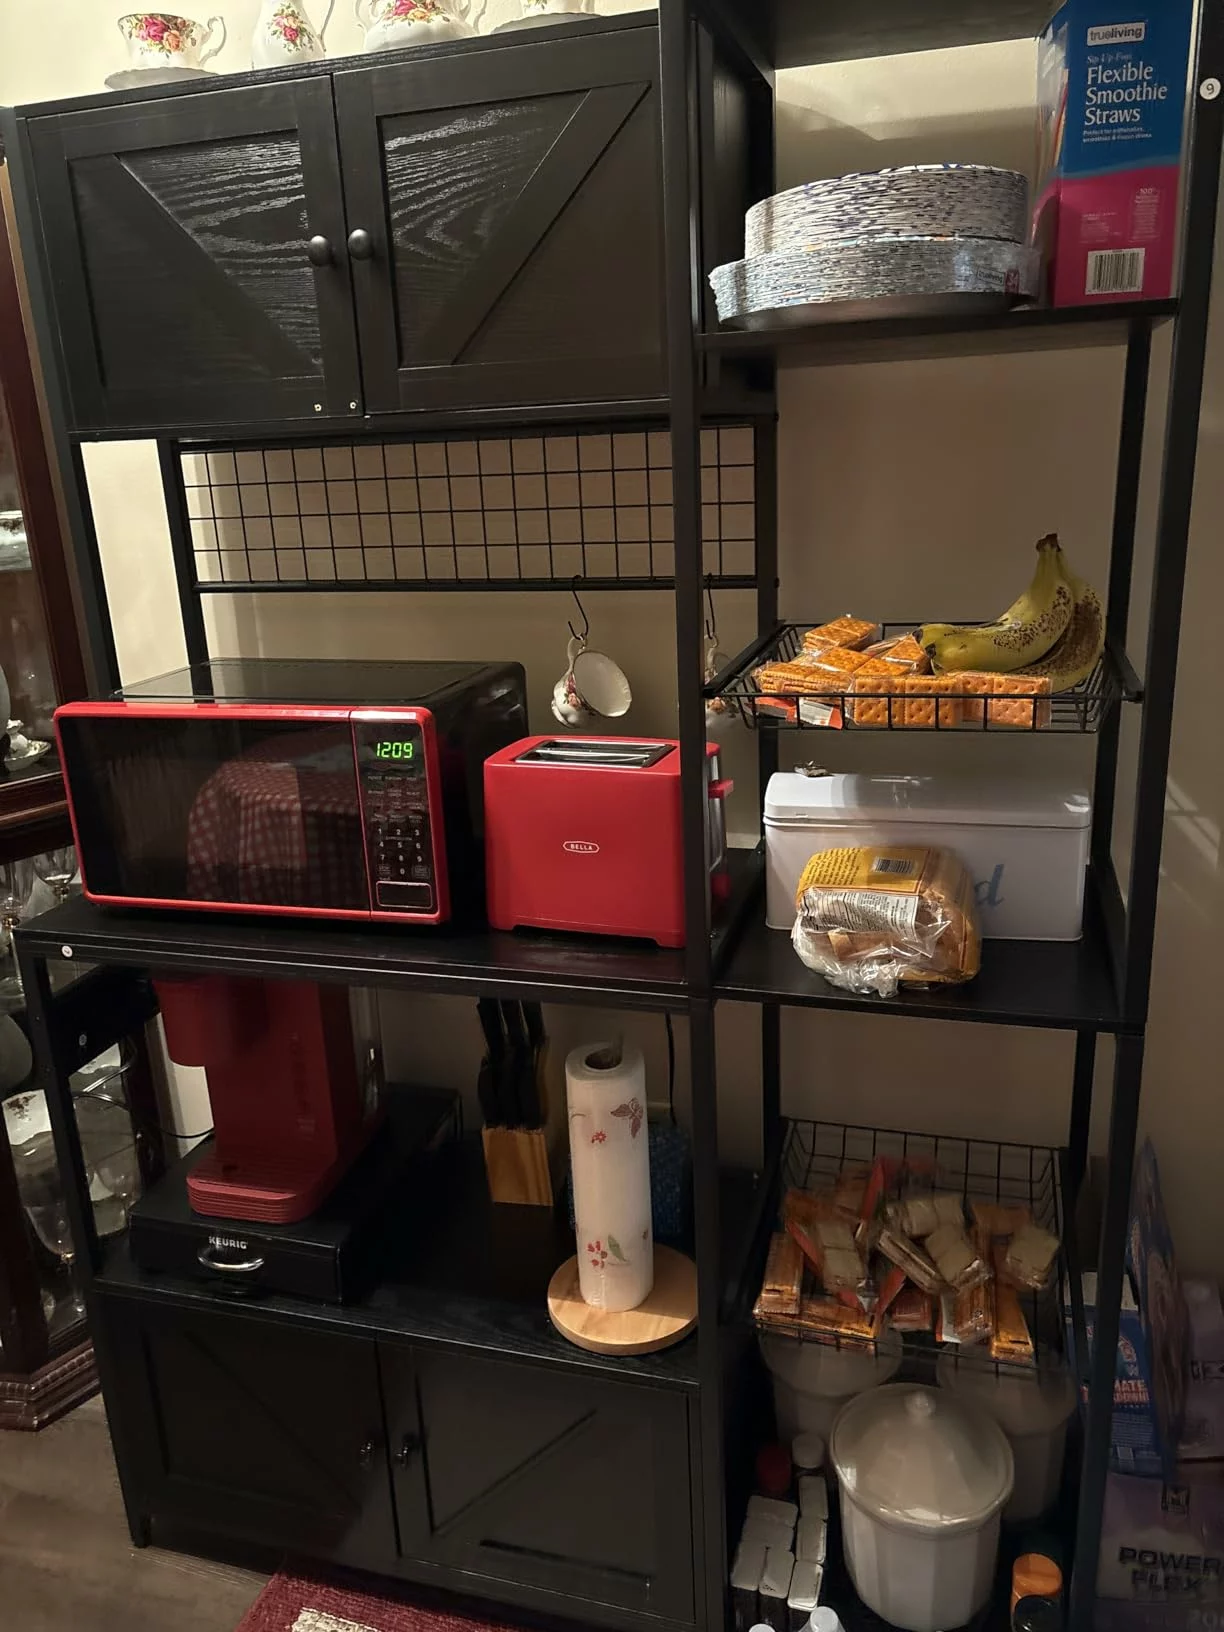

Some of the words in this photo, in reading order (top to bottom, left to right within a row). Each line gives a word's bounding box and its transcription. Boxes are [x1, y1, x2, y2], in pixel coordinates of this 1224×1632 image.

[1090, 27, 1142, 41] trueliving
[1087, 61, 1154, 85] Flexible
[1085, 81, 1168, 106] Smoothie
[1084, 107, 1141, 126] Straws
[376, 742, 412, 759] 1209
[570, 843, 592, 851] BELLA
[208, 1236, 247, 1250] KEURIG
[1118, 1547, 1224, 1575] POWER
